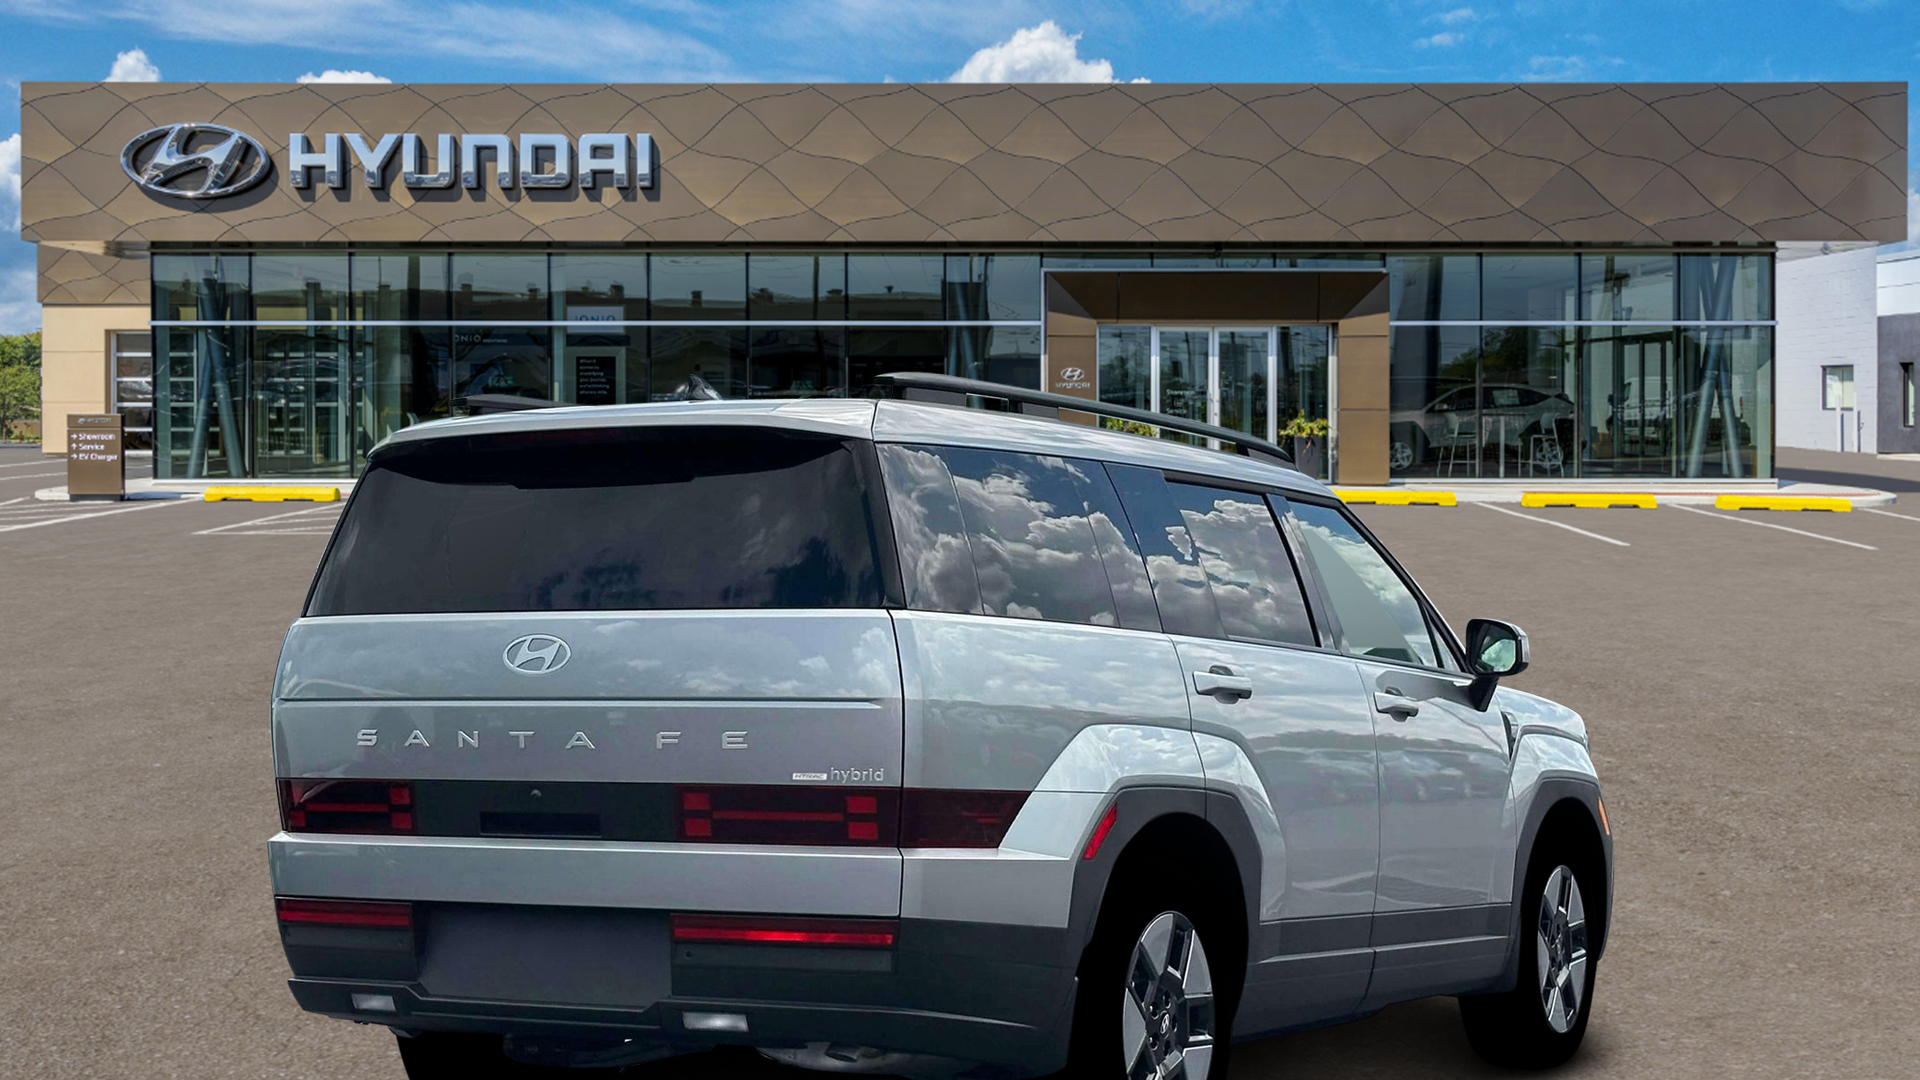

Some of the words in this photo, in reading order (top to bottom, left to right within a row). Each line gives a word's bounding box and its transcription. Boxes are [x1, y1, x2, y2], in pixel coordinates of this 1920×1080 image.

[289, 133, 654, 188] HYUNDAI
[79, 442, 105, 450] Service
[90, 453, 118, 462] Charger
[356, 729, 596, 750] SANTA
[656, 731, 749, 750] FE
[830, 767, 885, 783] hybrid
